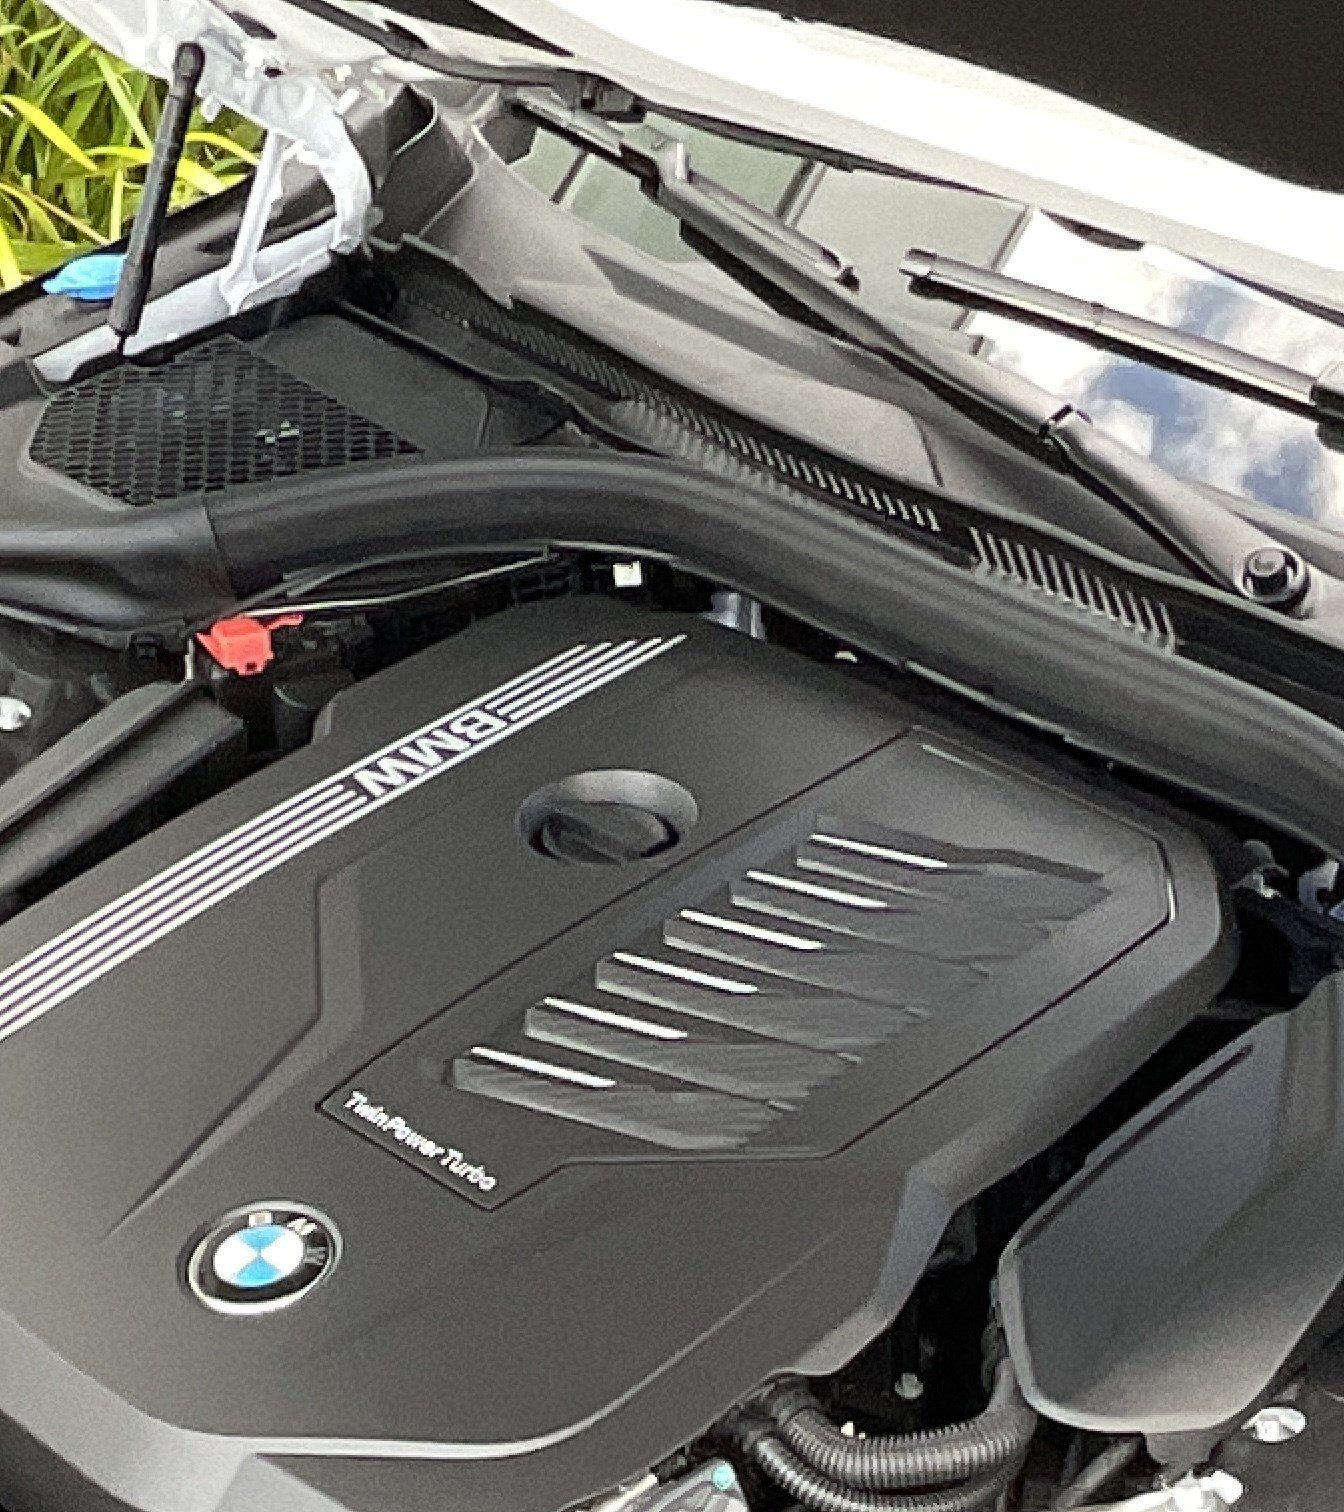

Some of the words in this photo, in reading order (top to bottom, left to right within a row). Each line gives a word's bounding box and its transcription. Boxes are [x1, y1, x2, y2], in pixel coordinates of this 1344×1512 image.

[353, 711, 507, 798] BMW
[344, 1091, 445, 1157] TwinPower
[441, 1149, 496, 1191] Turbo
